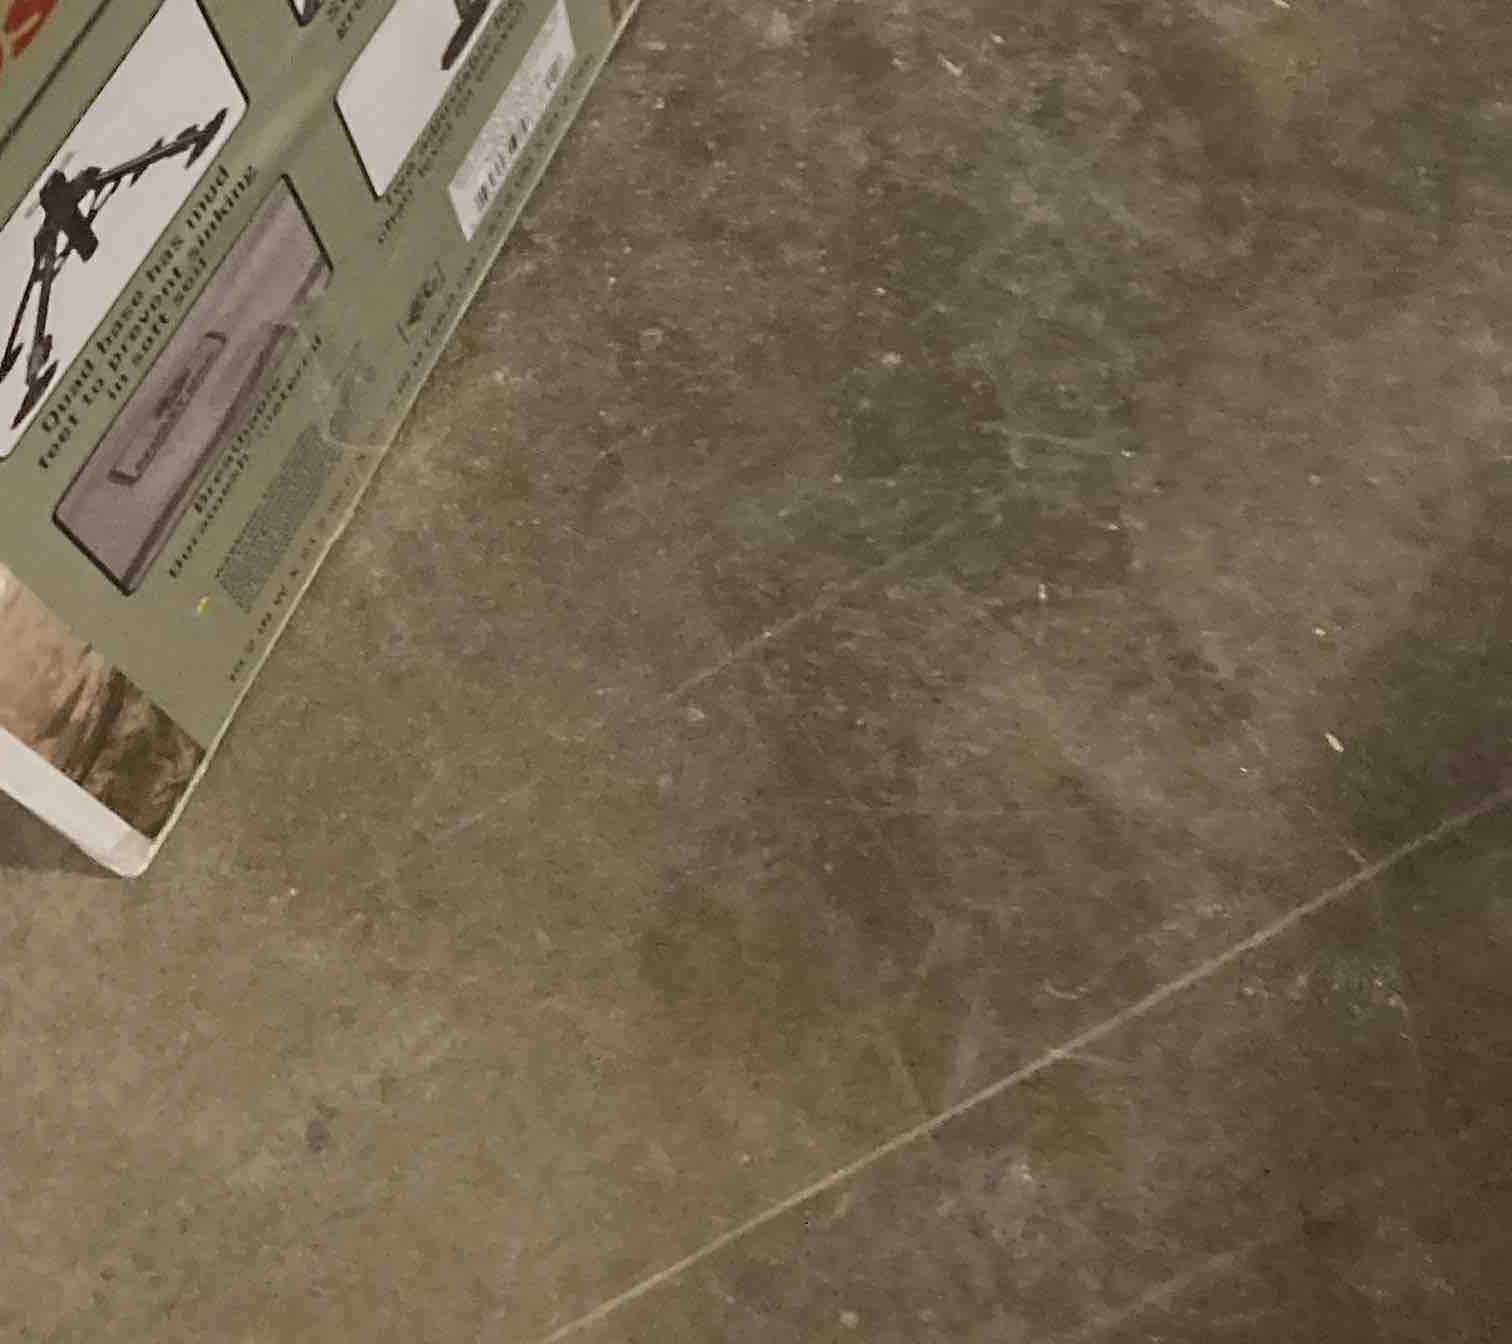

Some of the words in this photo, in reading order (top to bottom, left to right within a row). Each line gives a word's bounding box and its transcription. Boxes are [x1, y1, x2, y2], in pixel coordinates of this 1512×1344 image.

[38, 414, 78, 469] feet
[82, 378, 105, 405] to
[108, 265, 182, 372] prevent
[187, 164, 257, 258] sinking
[41, 358, 95, 433] Quad
[95, 290, 144, 355] base
[145, 234, 184, 283] has
[186, 165, 229, 230] mud
[108, 373, 129, 401] in
[133, 313, 169, 366] soft
[173, 257, 208, 308] soil
